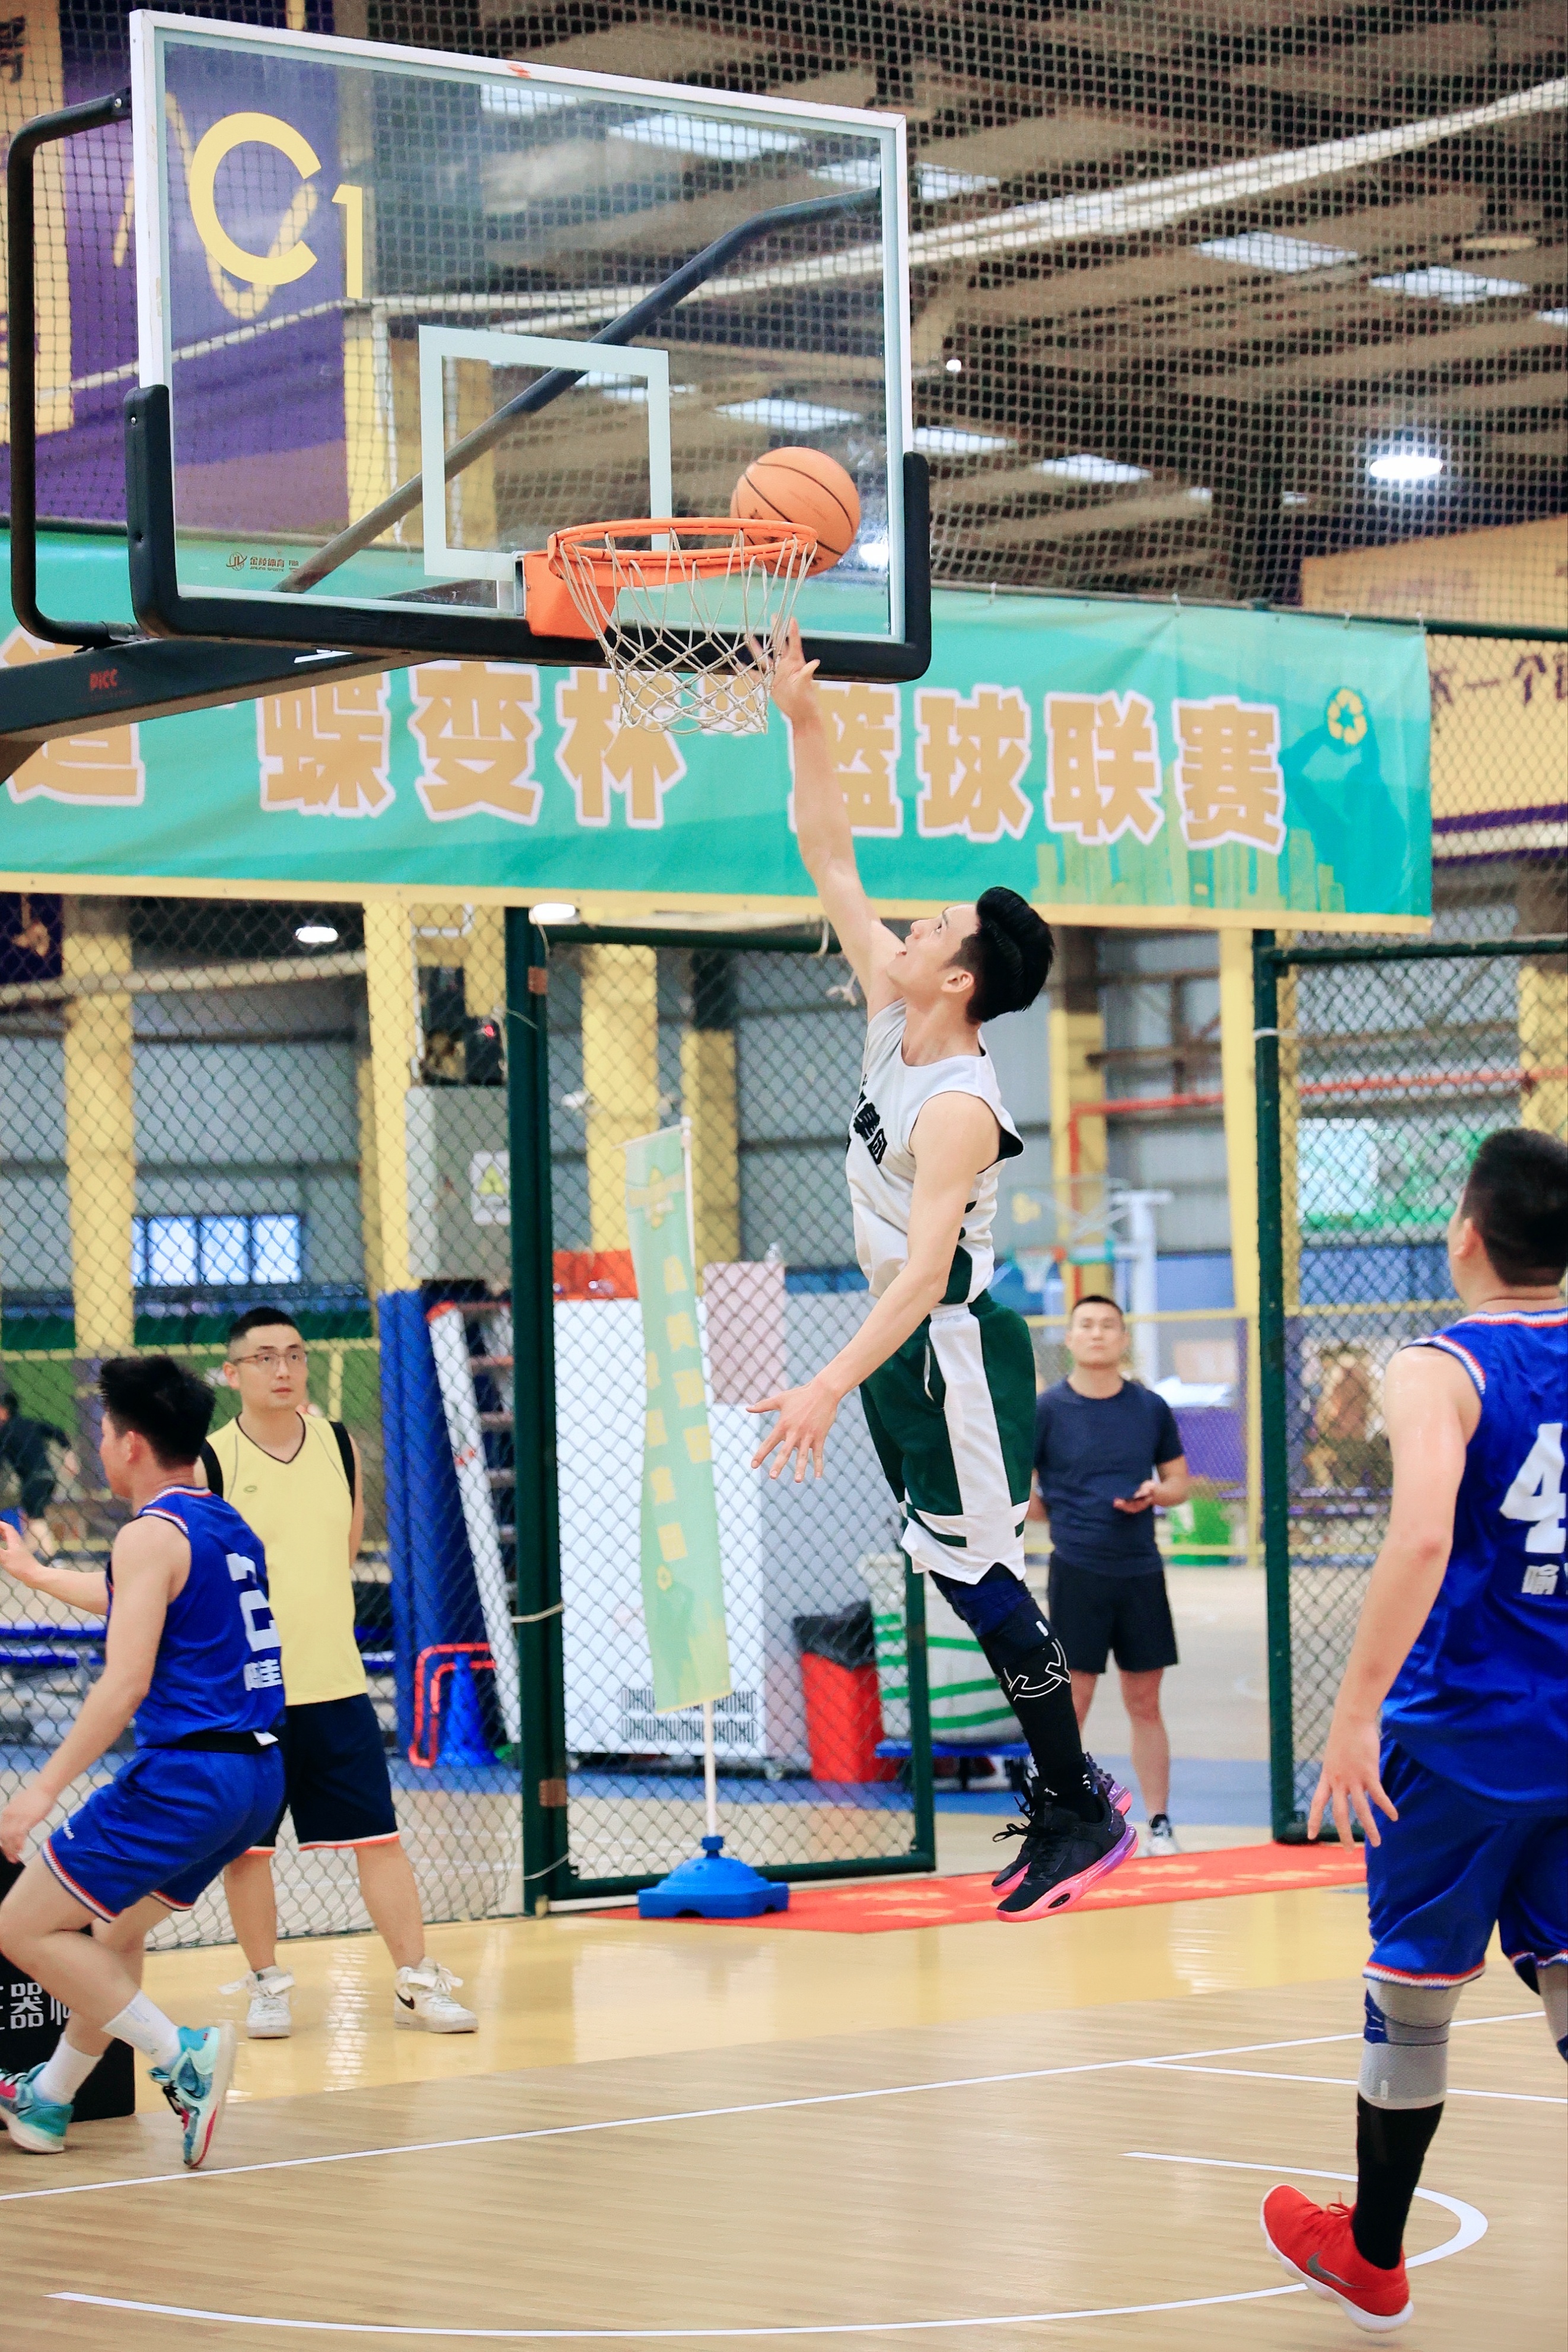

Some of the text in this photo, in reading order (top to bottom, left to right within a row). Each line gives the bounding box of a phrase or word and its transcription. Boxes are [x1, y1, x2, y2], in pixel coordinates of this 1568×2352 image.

[250, 557, 285, 567] 金陵体育
[1499, 1423, 1566, 1554] 4
[225, 1552, 282, 1653] 2
